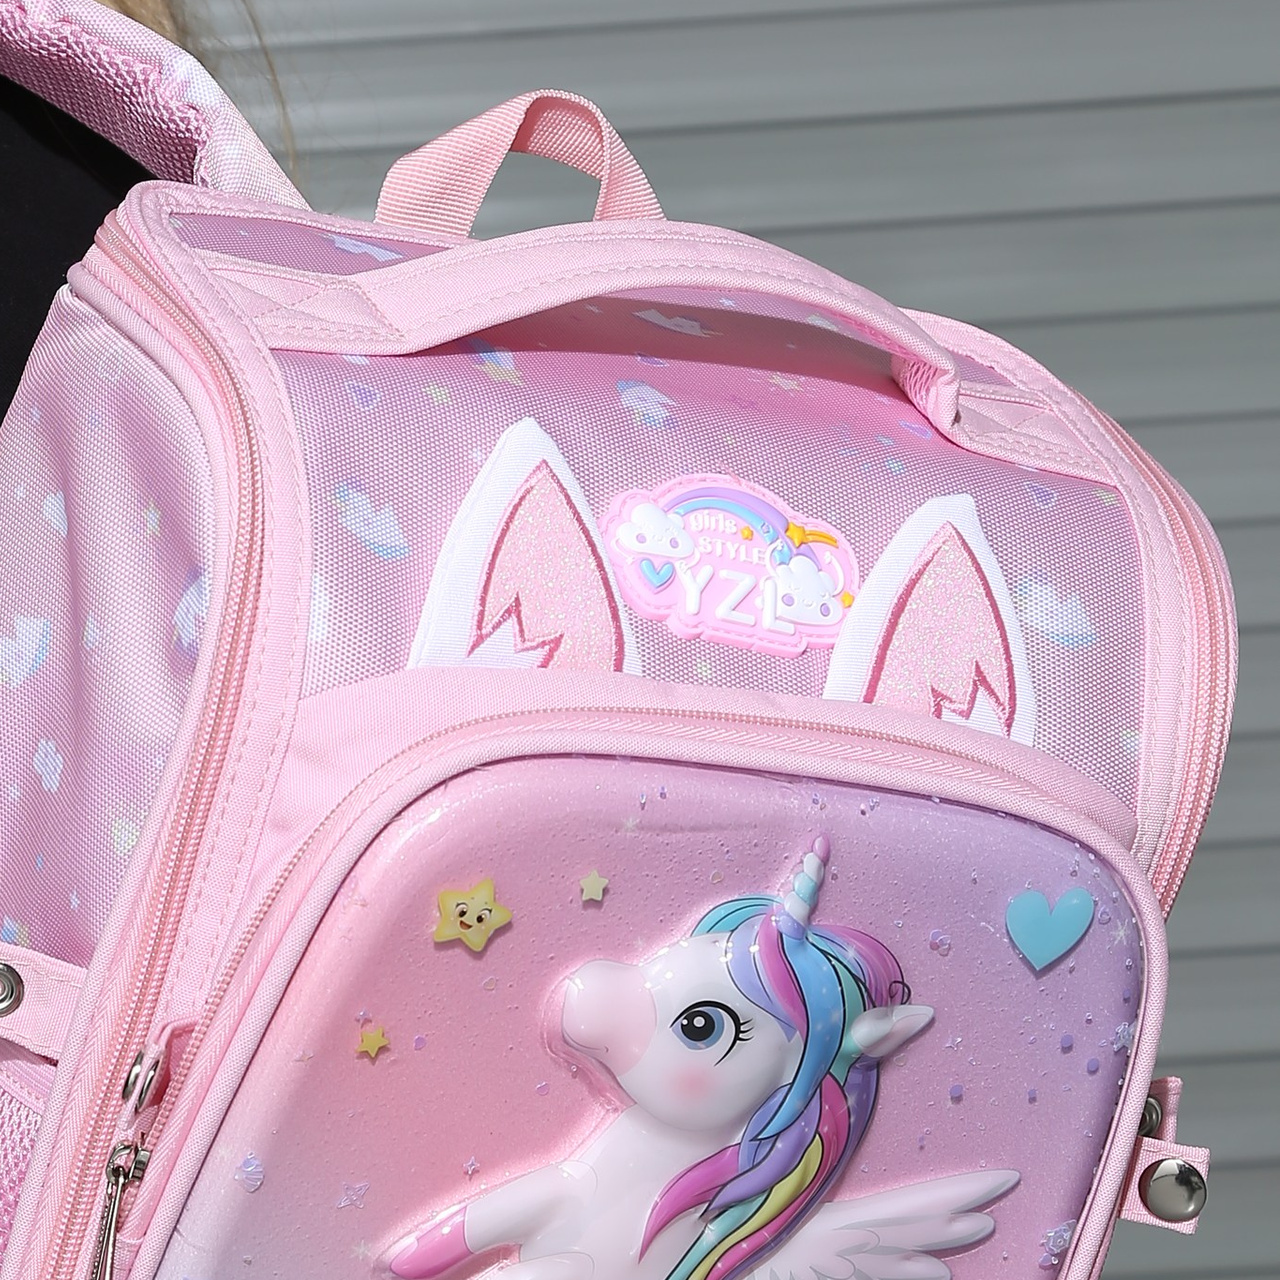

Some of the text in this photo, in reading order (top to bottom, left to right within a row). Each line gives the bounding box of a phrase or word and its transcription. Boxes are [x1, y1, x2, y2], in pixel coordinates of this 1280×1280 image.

[689, 510, 737, 535] girls
[698, 536, 769, 565] STYLE
[675, 565, 796, 636] YZL
